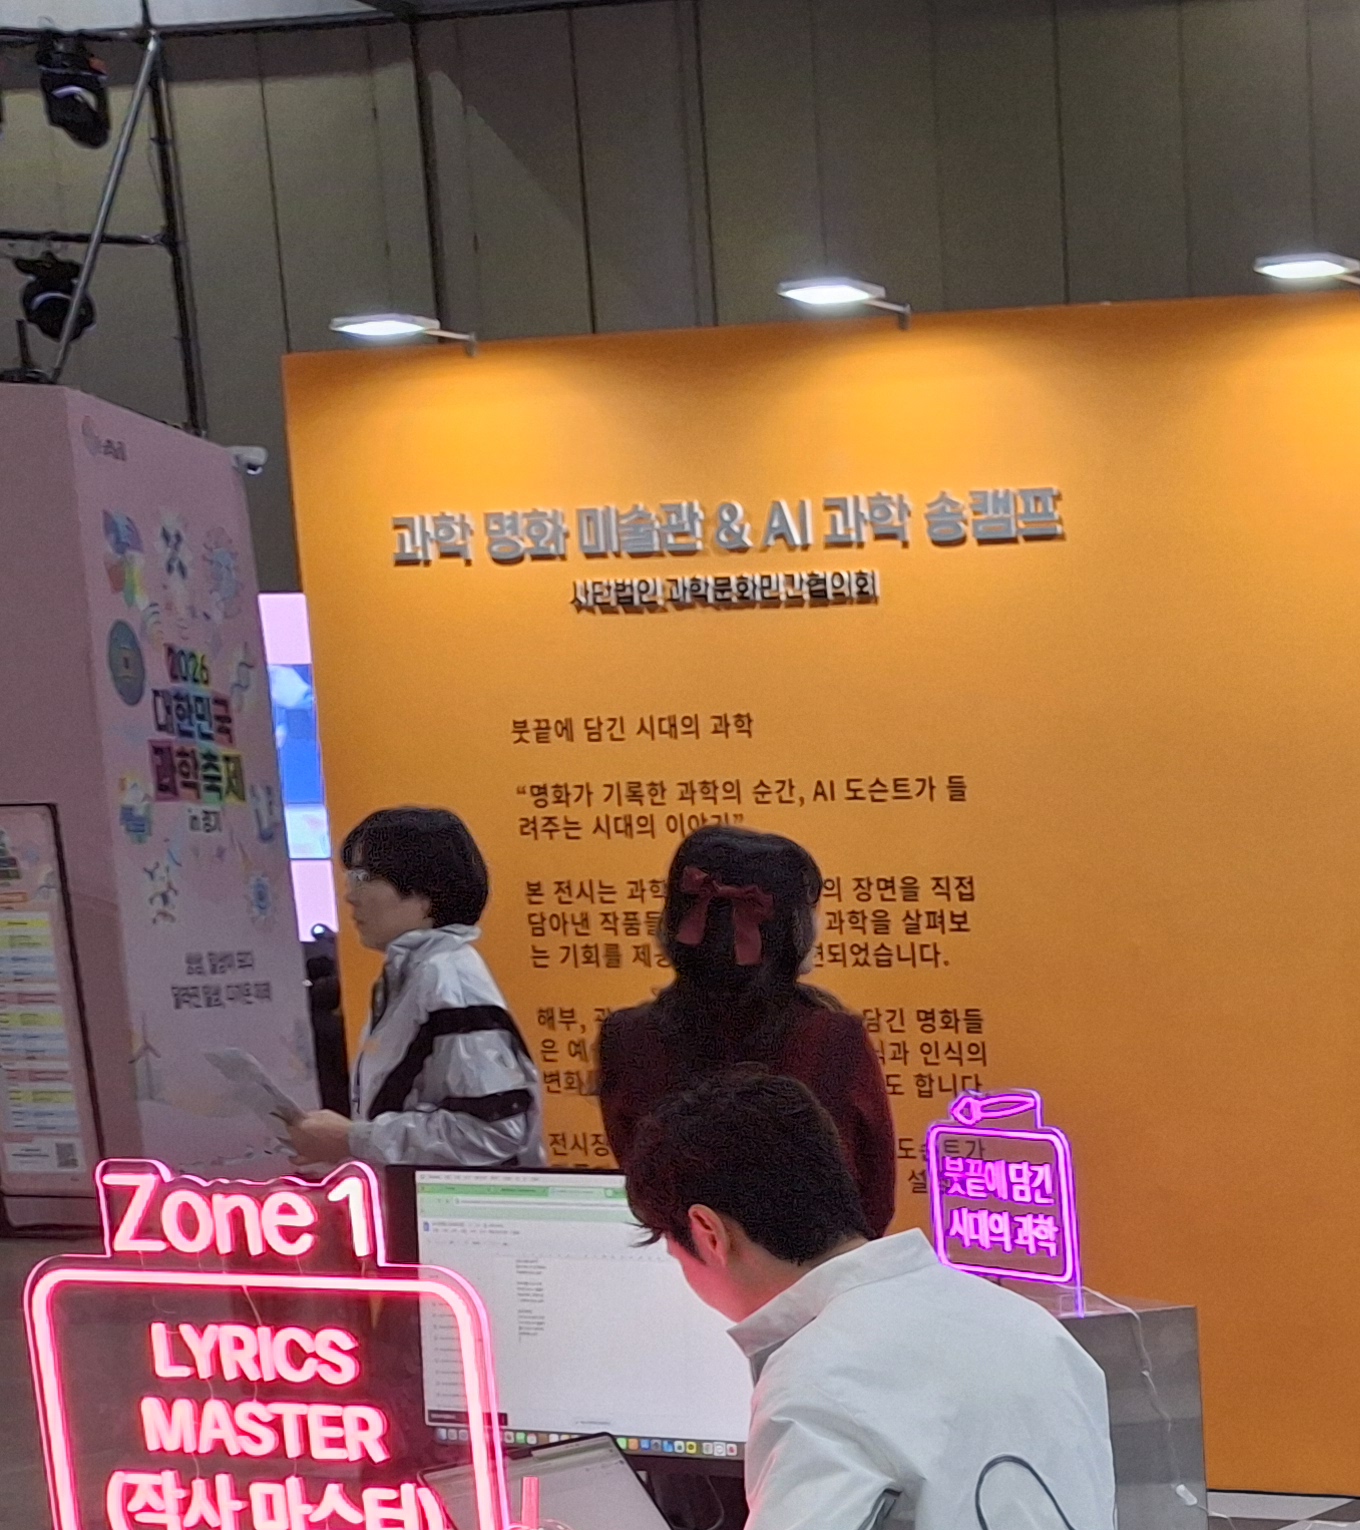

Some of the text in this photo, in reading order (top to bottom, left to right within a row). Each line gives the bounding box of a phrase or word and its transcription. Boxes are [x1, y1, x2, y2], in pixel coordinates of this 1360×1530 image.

[392, 486, 1065, 565] 과학 명화 미술관 & AI 과학 송캠프
[571, 569, 879, 609] 사단법인 과학문화민간협의회
[166, 645, 210, 685] 2026
[152, 687, 234, 744] 대한민국
[510, 711, 755, 744] 붓끝에 담긴 시대의 과학
[516, 775, 968, 809] “명화가 기록한 과학의 순간, AI 도슨트가 들
[518, 814, 583, 841] 려주는
[591, 812, 656, 840] 시대의
[526, 880, 546, 905] 본
[553, 878, 618, 905] 전시는
[851, 875, 921, 903] 장면을
[929, 874, 976, 902] 직접
[527, 911, 591, 938] 담아낸
[825, 908, 892, 936] 과학을
[901, 908, 971, 935] 살펴보
[530, 944, 550, 969] 는
[558, 943, 623, 969] 기회를
[537, 1006, 587, 1034] 해부,
[862, 1007, 906, 1033] 담긴
[915, 1007, 984, 1034] 명화들
[540, 1038, 559, 1063] 은
[919, 1040, 988, 1067] 인식의
[1008, 1161, 1055, 1205] 담긴
[101, 1172, 374, 1258] Zone 1
[949, 1207, 1059, 1258] 시대의 과학
[149, 1321, 361, 1385] LYRICS
[139, 1396, 392, 1464] MASTER
